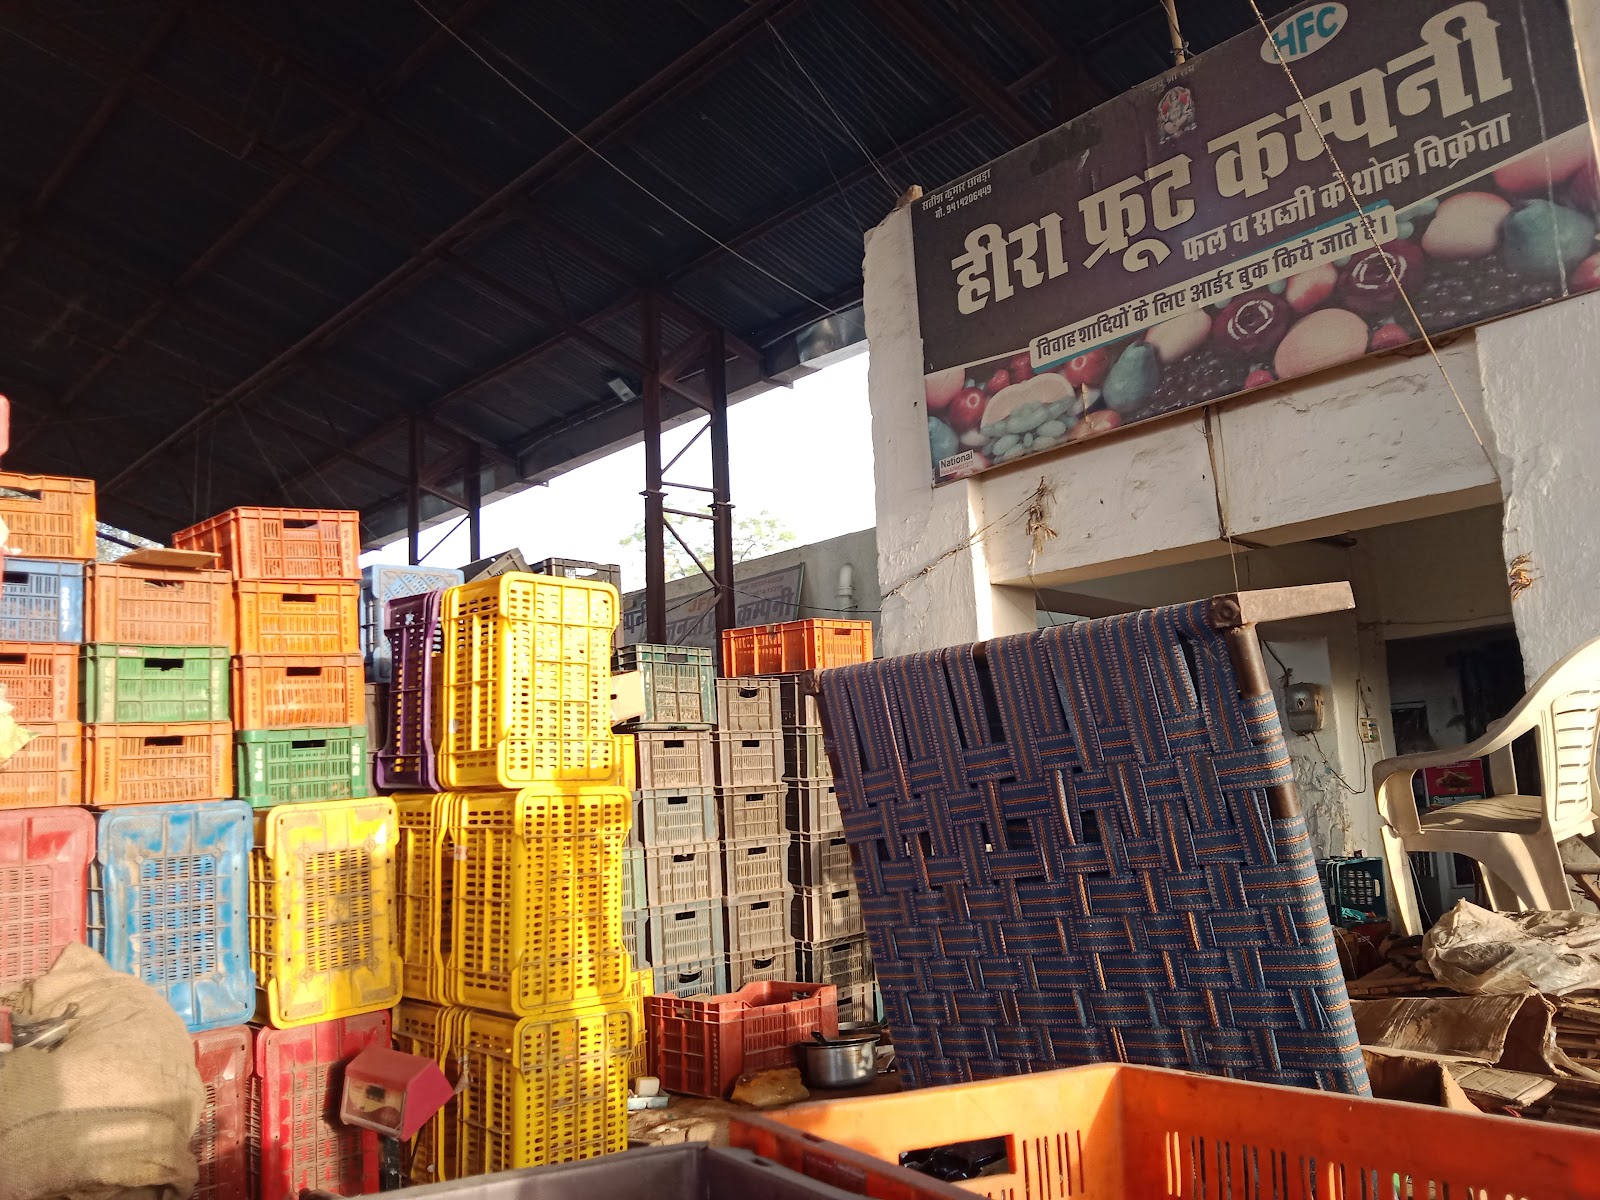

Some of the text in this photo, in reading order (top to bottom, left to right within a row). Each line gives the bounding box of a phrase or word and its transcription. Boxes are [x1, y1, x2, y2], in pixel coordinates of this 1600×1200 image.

[1272, 6, 1339, 60] HFC
[951, 1, 1513, 315] हीरा फ्रूट कम्पनी
[921, 192, 944, 211] सतीश
[944, 181, 966, 202] कुमार
[946, 184, 992, 214] 9414206449
[1182, 113, 1511, 262] फल व सब्जी के थोक विक्रेता
[1036, 330, 1076, 359] विवाह
[1077, 304, 1132, 343] शादियों
[1132, 299, 1150, 322] के
[1152, 289, 1186, 316] लिए
[1189, 269, 1235, 302] आर्डर
[1236, 258, 1270, 290] बुक
[1272, 238, 1314, 273] किये
[1316, 222, 1359, 256] जाते
[940, 450, 973, 469] National
[61, 586, 70, 632] 2017
[56, 665, 66, 714] 2021
